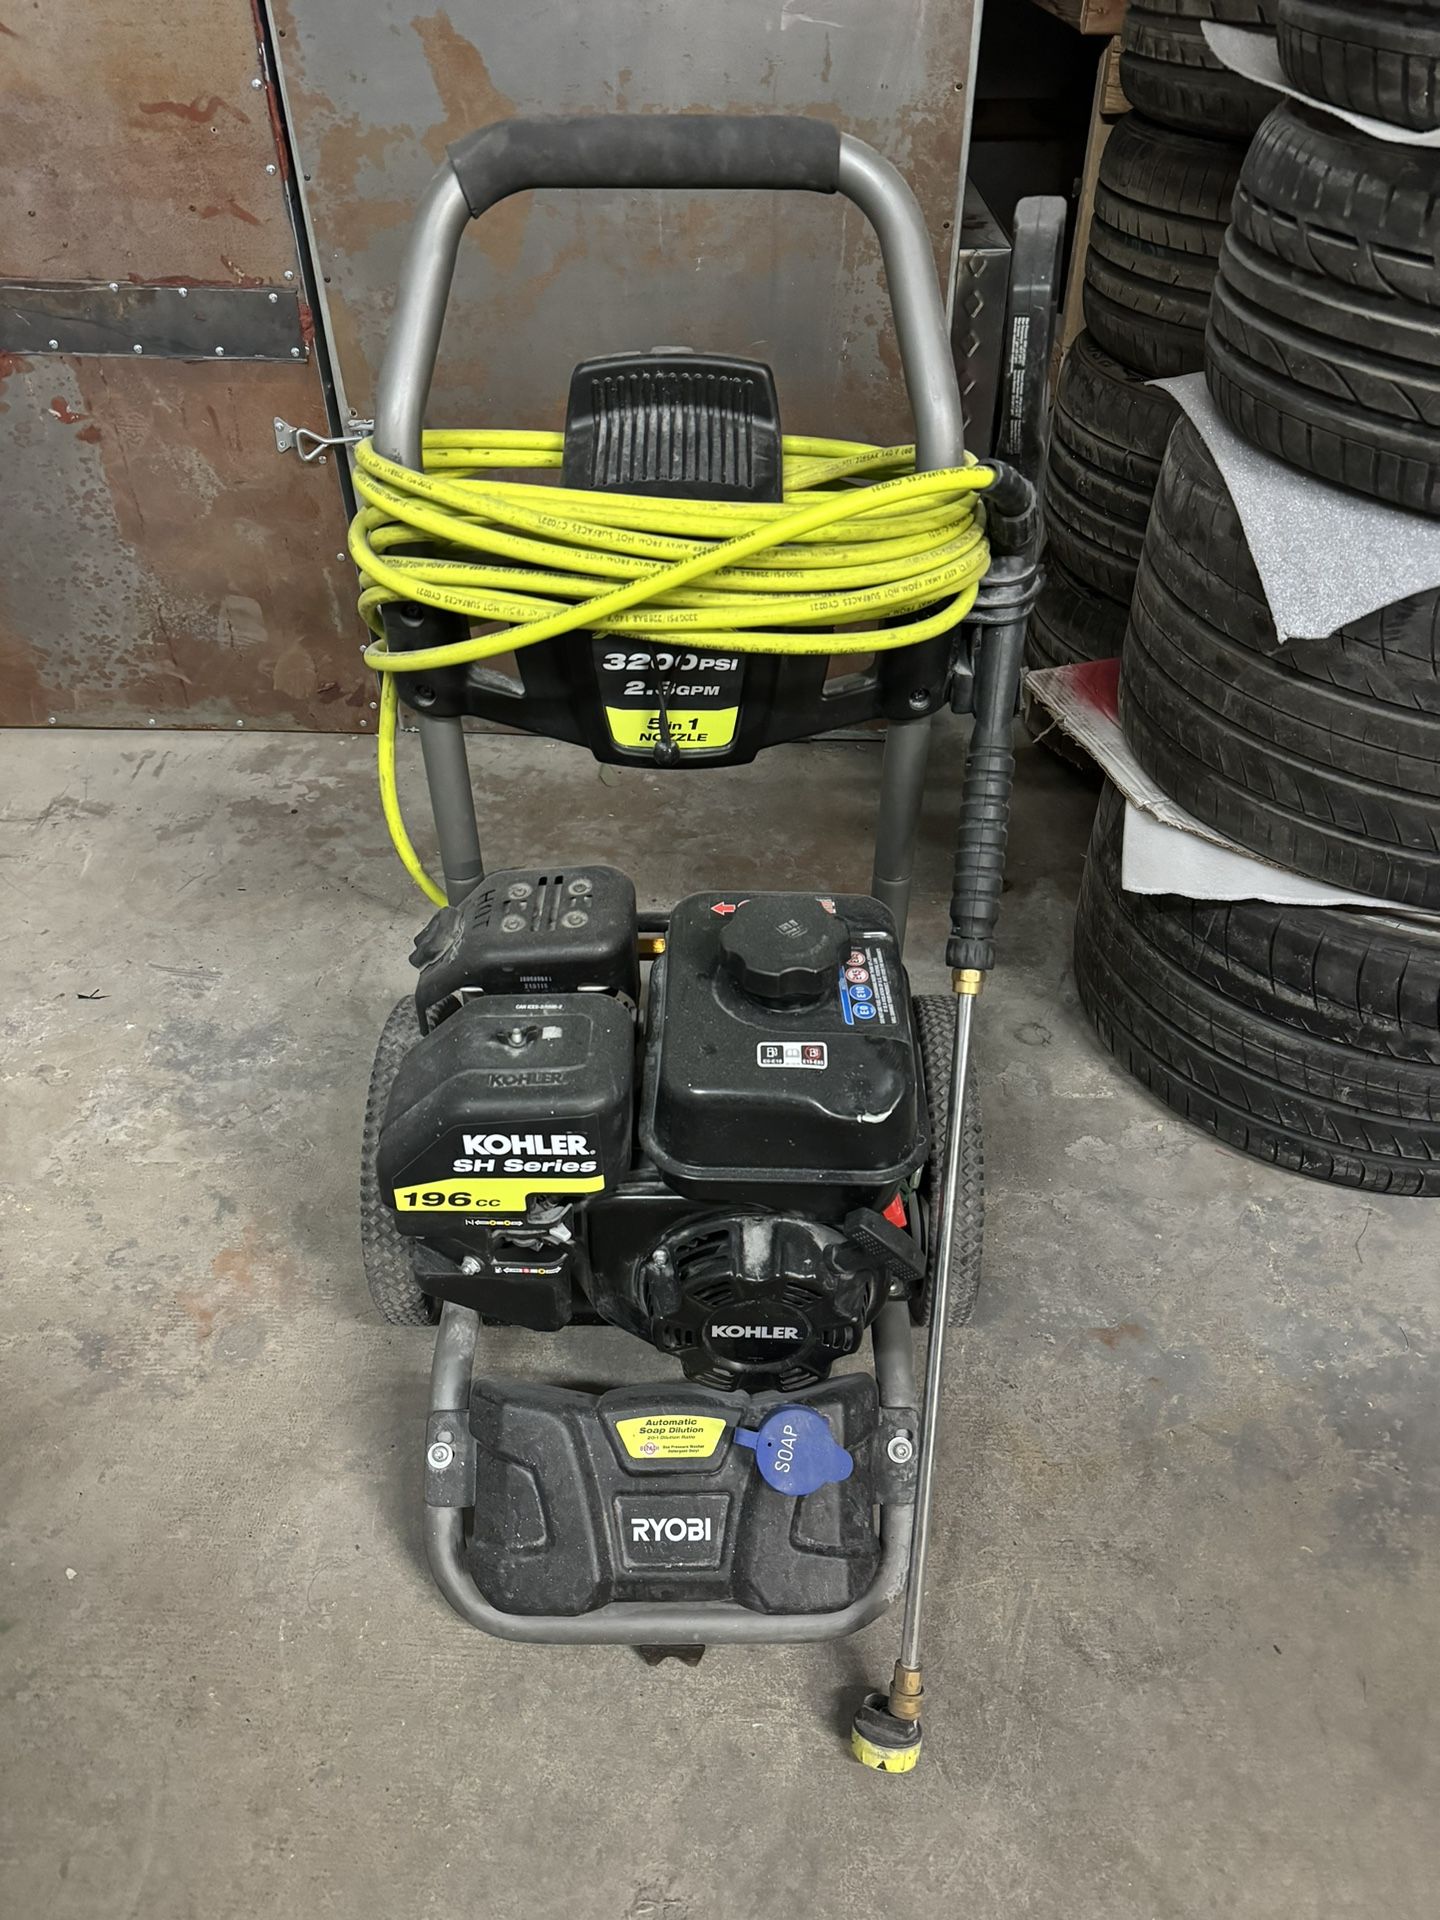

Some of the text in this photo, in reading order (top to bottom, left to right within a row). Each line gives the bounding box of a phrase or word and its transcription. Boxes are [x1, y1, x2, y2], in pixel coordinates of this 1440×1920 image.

[906, 470, 946, 483] SURFACES
[572, 523, 613, 539] SURFACES
[616, 534, 634, 543] HOT
[640, 538, 662, 547] FROM
[884, 588, 900, 598] HOT
[902, 581, 922, 592] FROM
[416, 588, 441, 601] CY0221
[842, 590, 880, 606] SURFACES
[444, 595, 480, 610] SURFACES
[810, 600, 839, 612] CY0221
[668, 721, 682, 730] in
[688, 718, 698, 730] 1
[855, 986, 866, 998] E10
[489, 1072, 565, 1086] KOHLER
[462, 1134, 590, 1156] KOHLER
[452, 1158, 597, 1173] SH Series
[403, 1192, 472, 1207] 196
[711, 1325, 799, 1340] KOHLER
[646, 1418, 698, 1426] Automatic
[639, 1426, 704, 1435] Soap Dilution
[774, 1424, 799, 1473] SOAP
[630, 1517, 711, 1542] RYOBI
